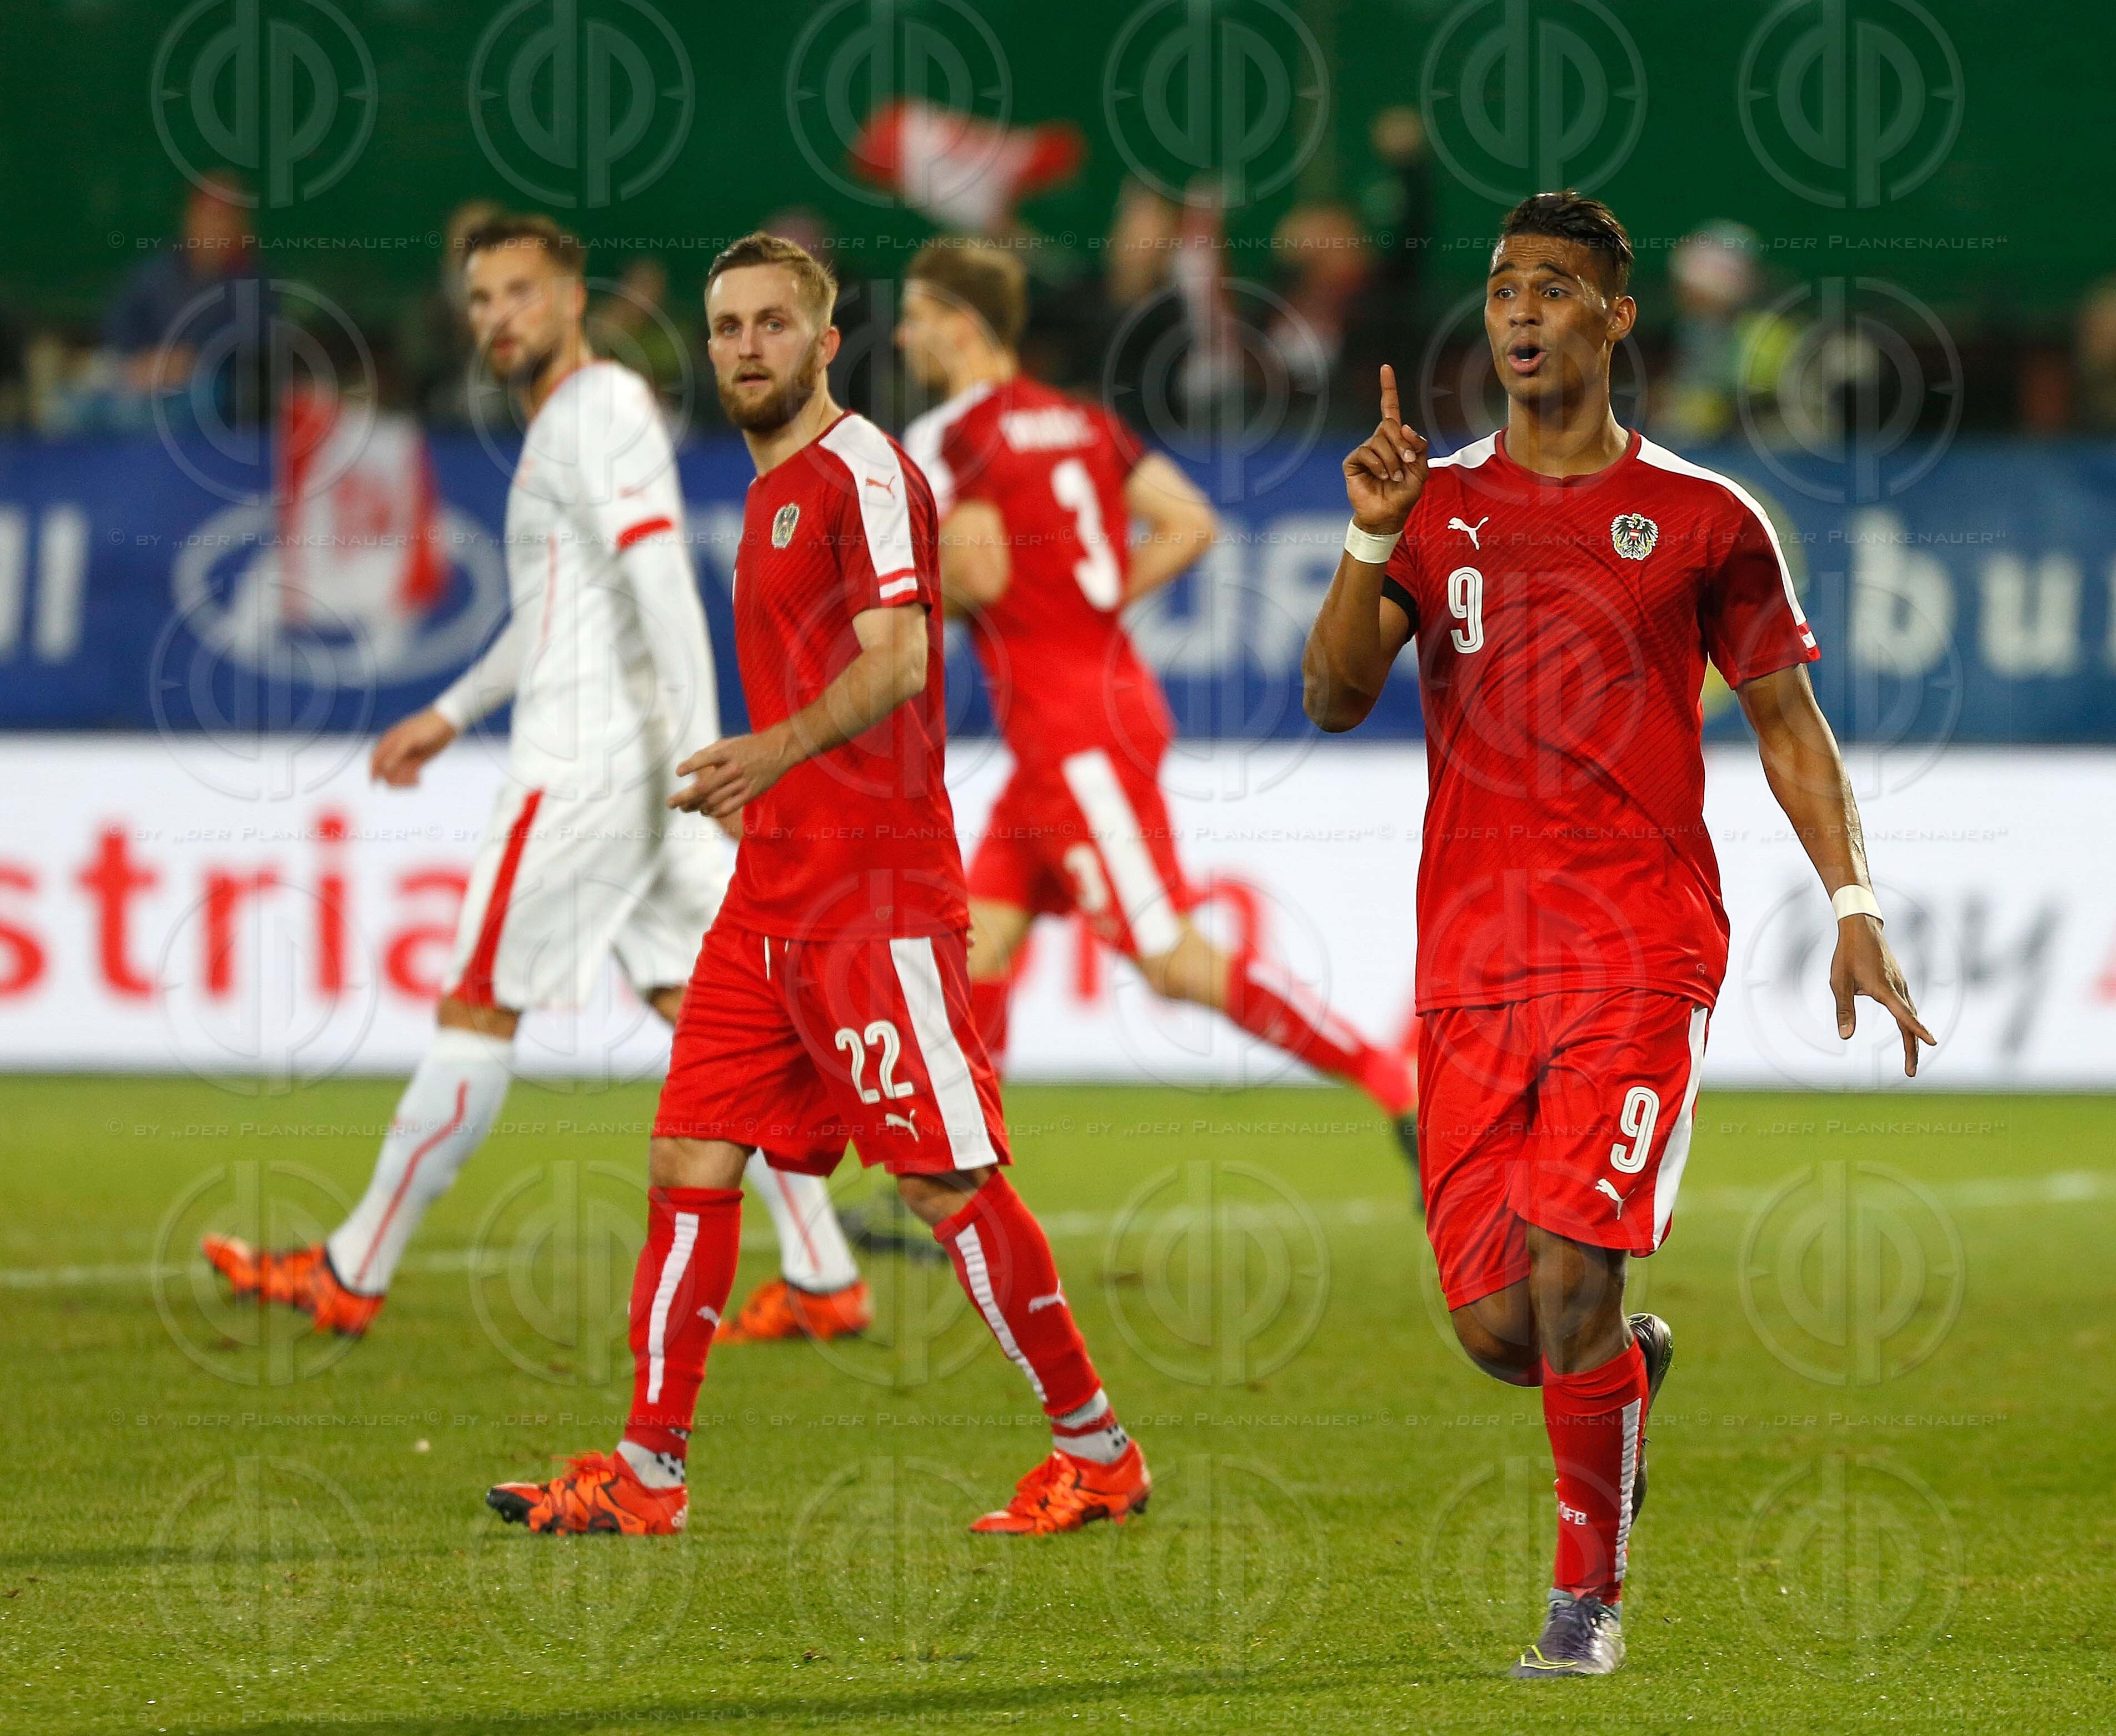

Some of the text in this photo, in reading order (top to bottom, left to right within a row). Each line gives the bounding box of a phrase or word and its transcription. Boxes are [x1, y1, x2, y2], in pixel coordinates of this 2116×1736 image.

[1447, 566, 1484, 654] 9
[835, 1020, 914, 1104] 22
[1610, 1086, 1660, 1174] 9
